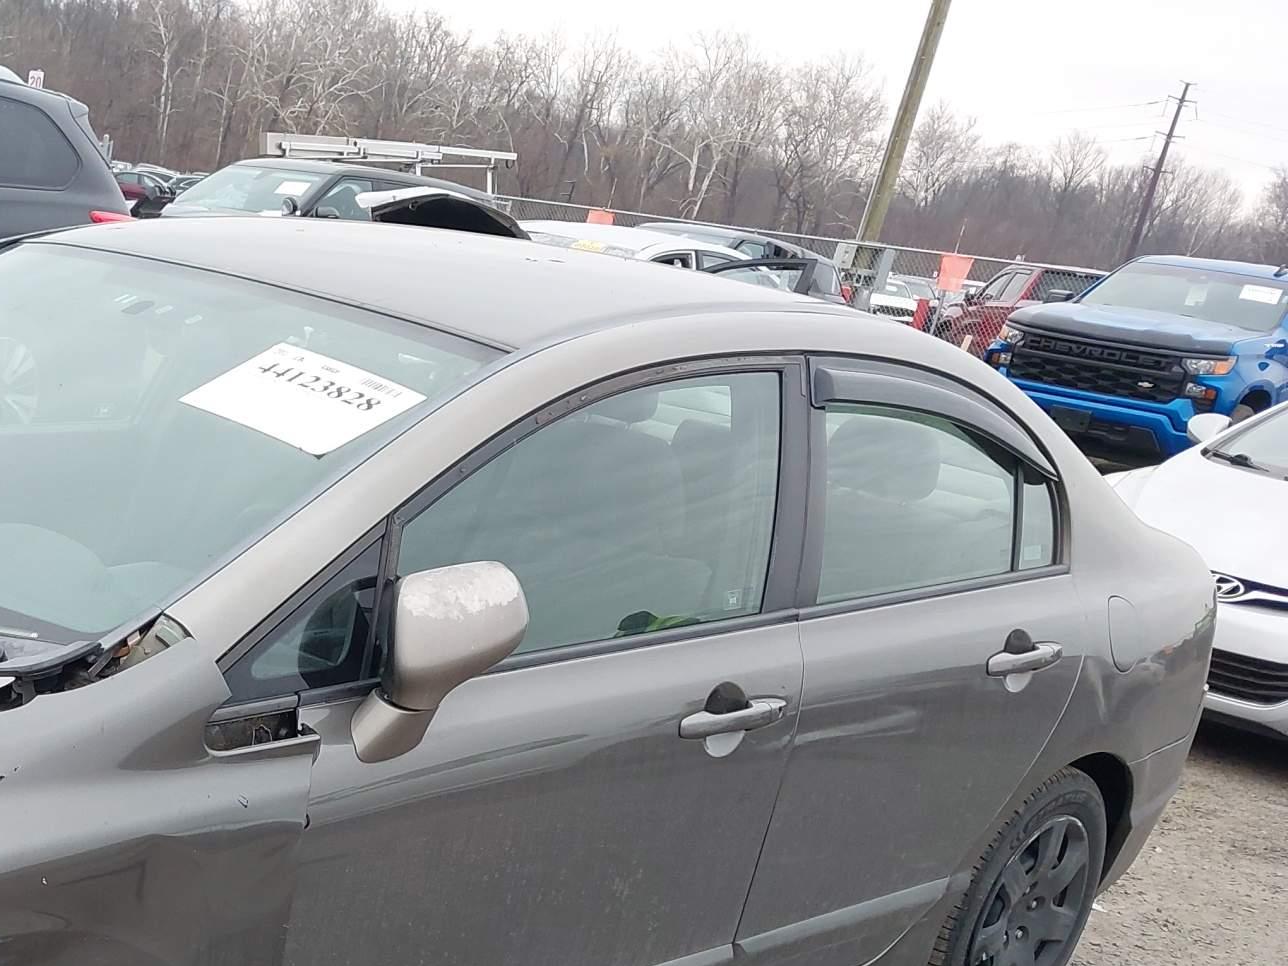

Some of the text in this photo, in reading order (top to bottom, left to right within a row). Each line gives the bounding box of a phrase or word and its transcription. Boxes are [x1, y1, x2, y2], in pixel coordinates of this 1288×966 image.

[30, 75, 43, 88] 20
[1025, 335, 1169, 371] CHEVROLET
[258, 362, 381, 411] 44123828
